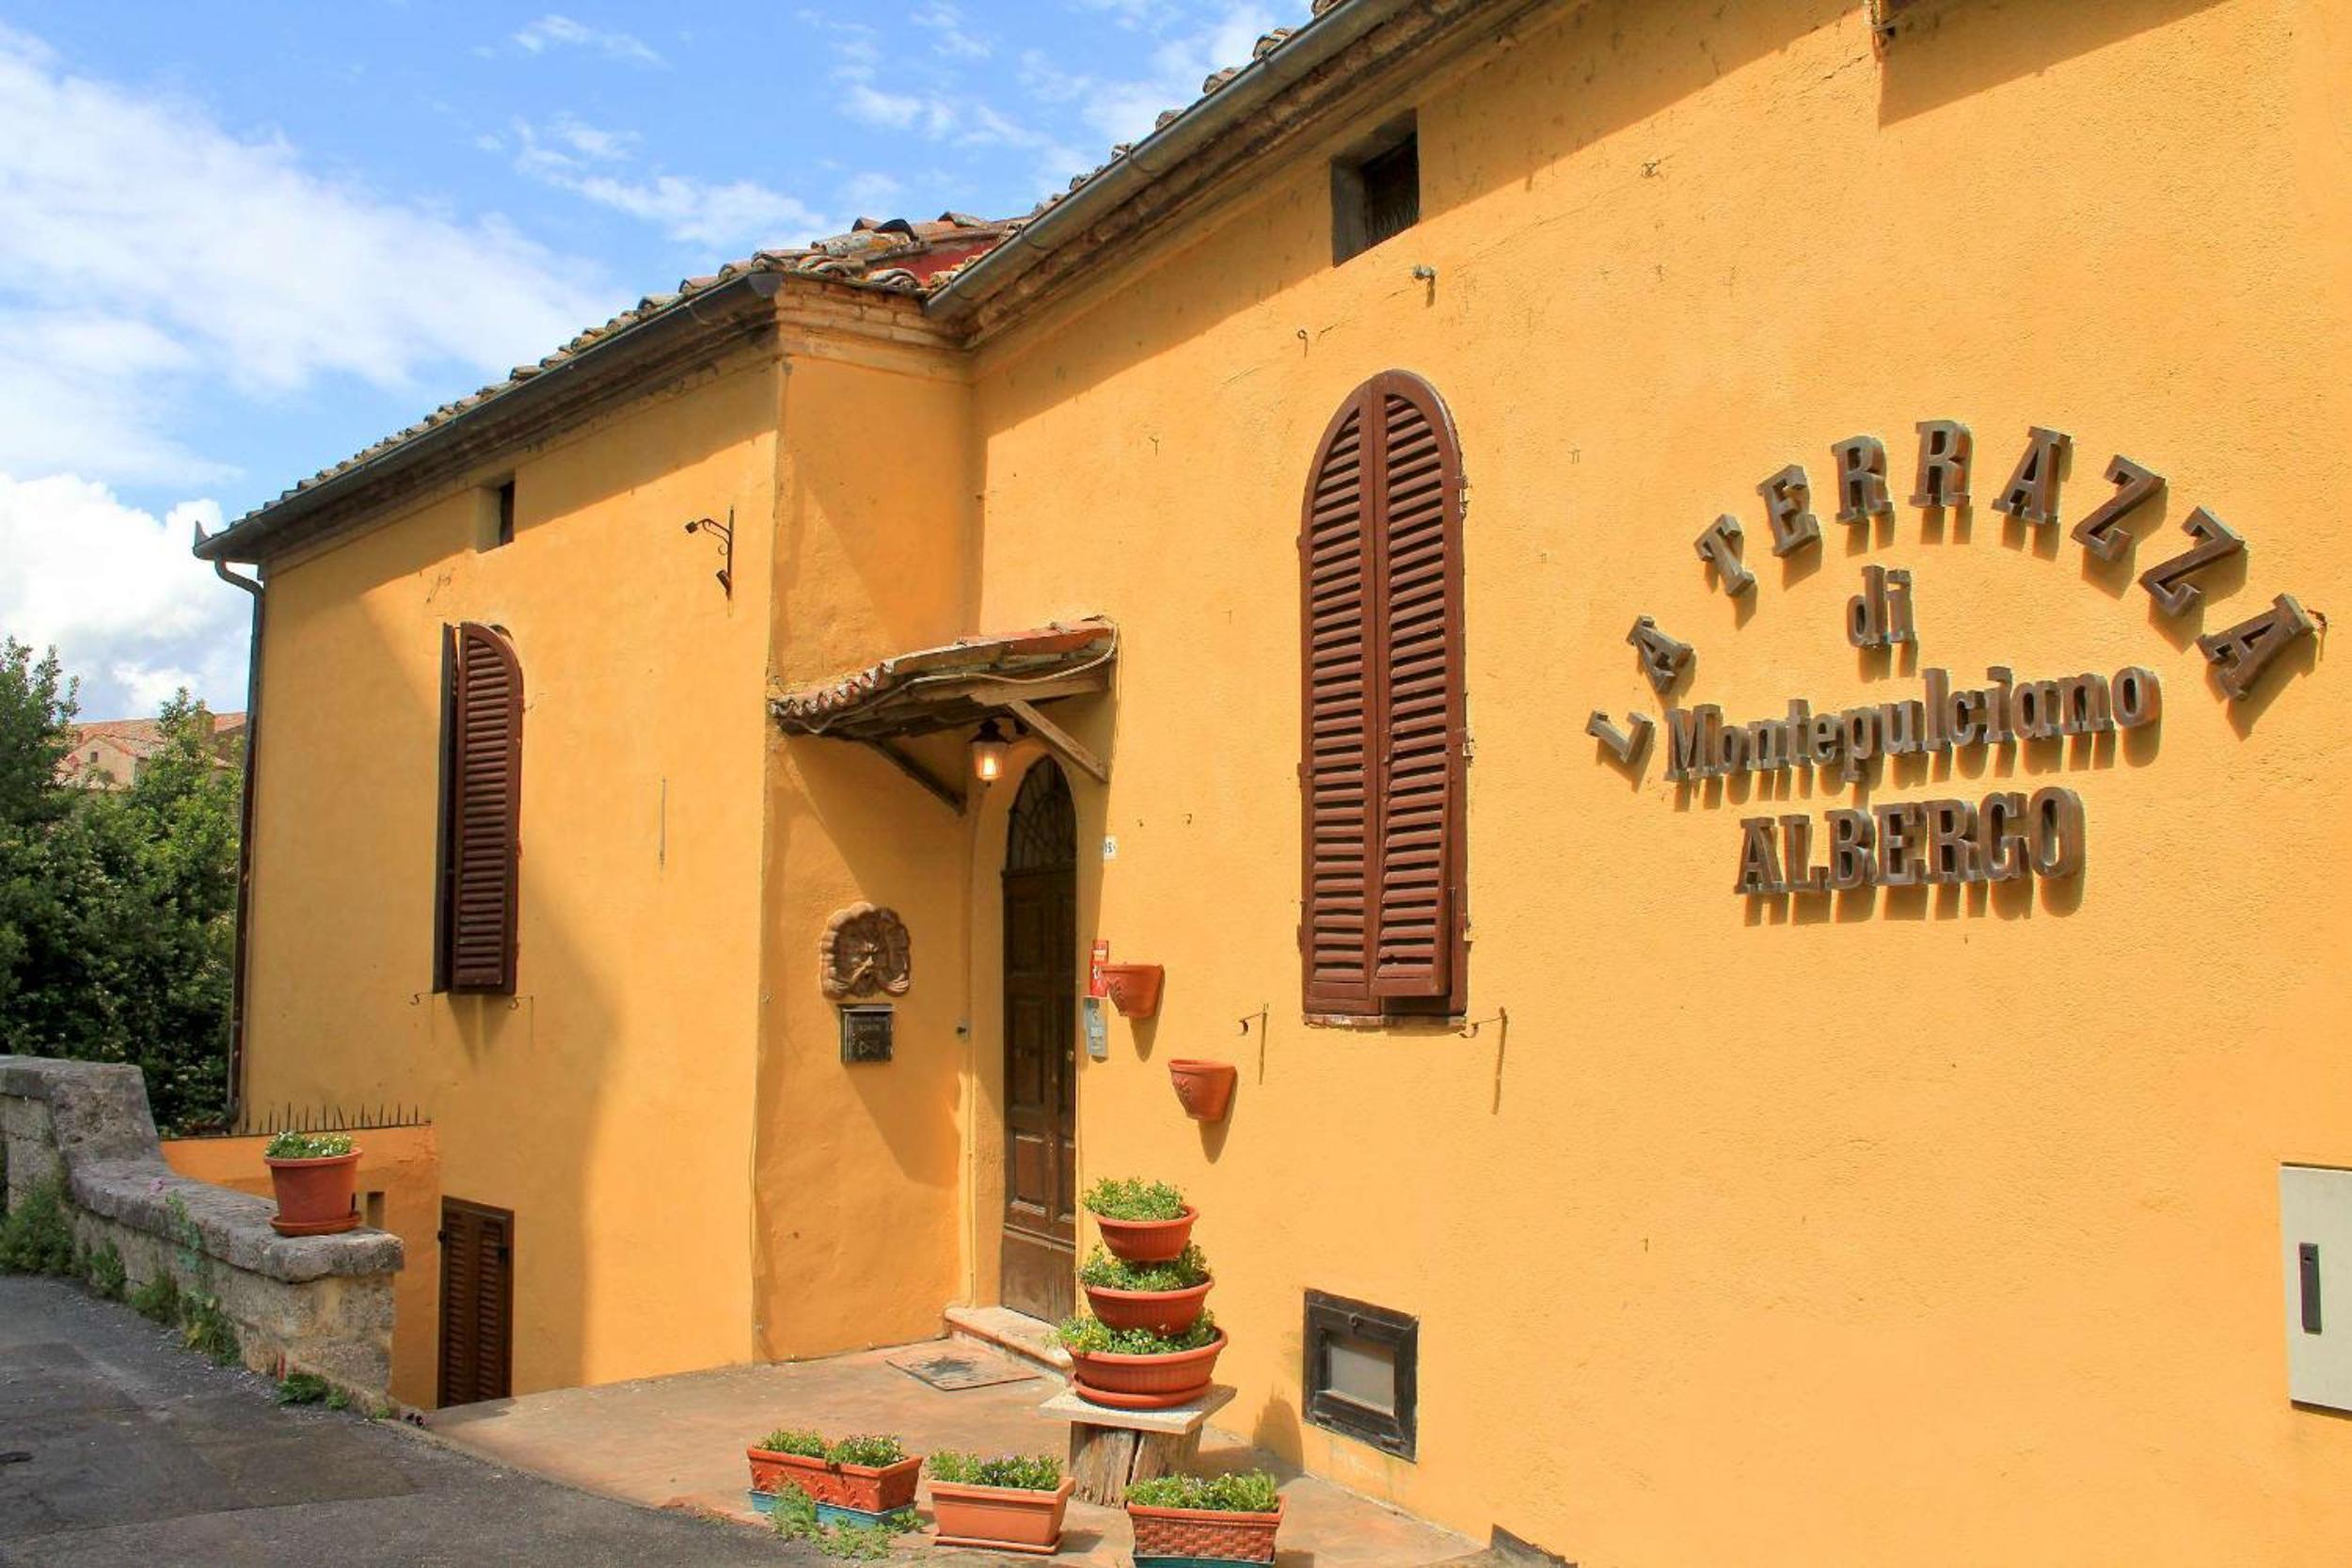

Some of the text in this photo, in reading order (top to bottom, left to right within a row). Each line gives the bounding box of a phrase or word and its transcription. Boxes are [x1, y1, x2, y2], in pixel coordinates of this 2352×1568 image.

[1584, 419, 2317, 764] LA TERRAZZA
[1846, 564, 1914, 648] di
[1663, 665, 2161, 783] Montepulciano
[1734, 785, 2085, 895] ALBERGO
